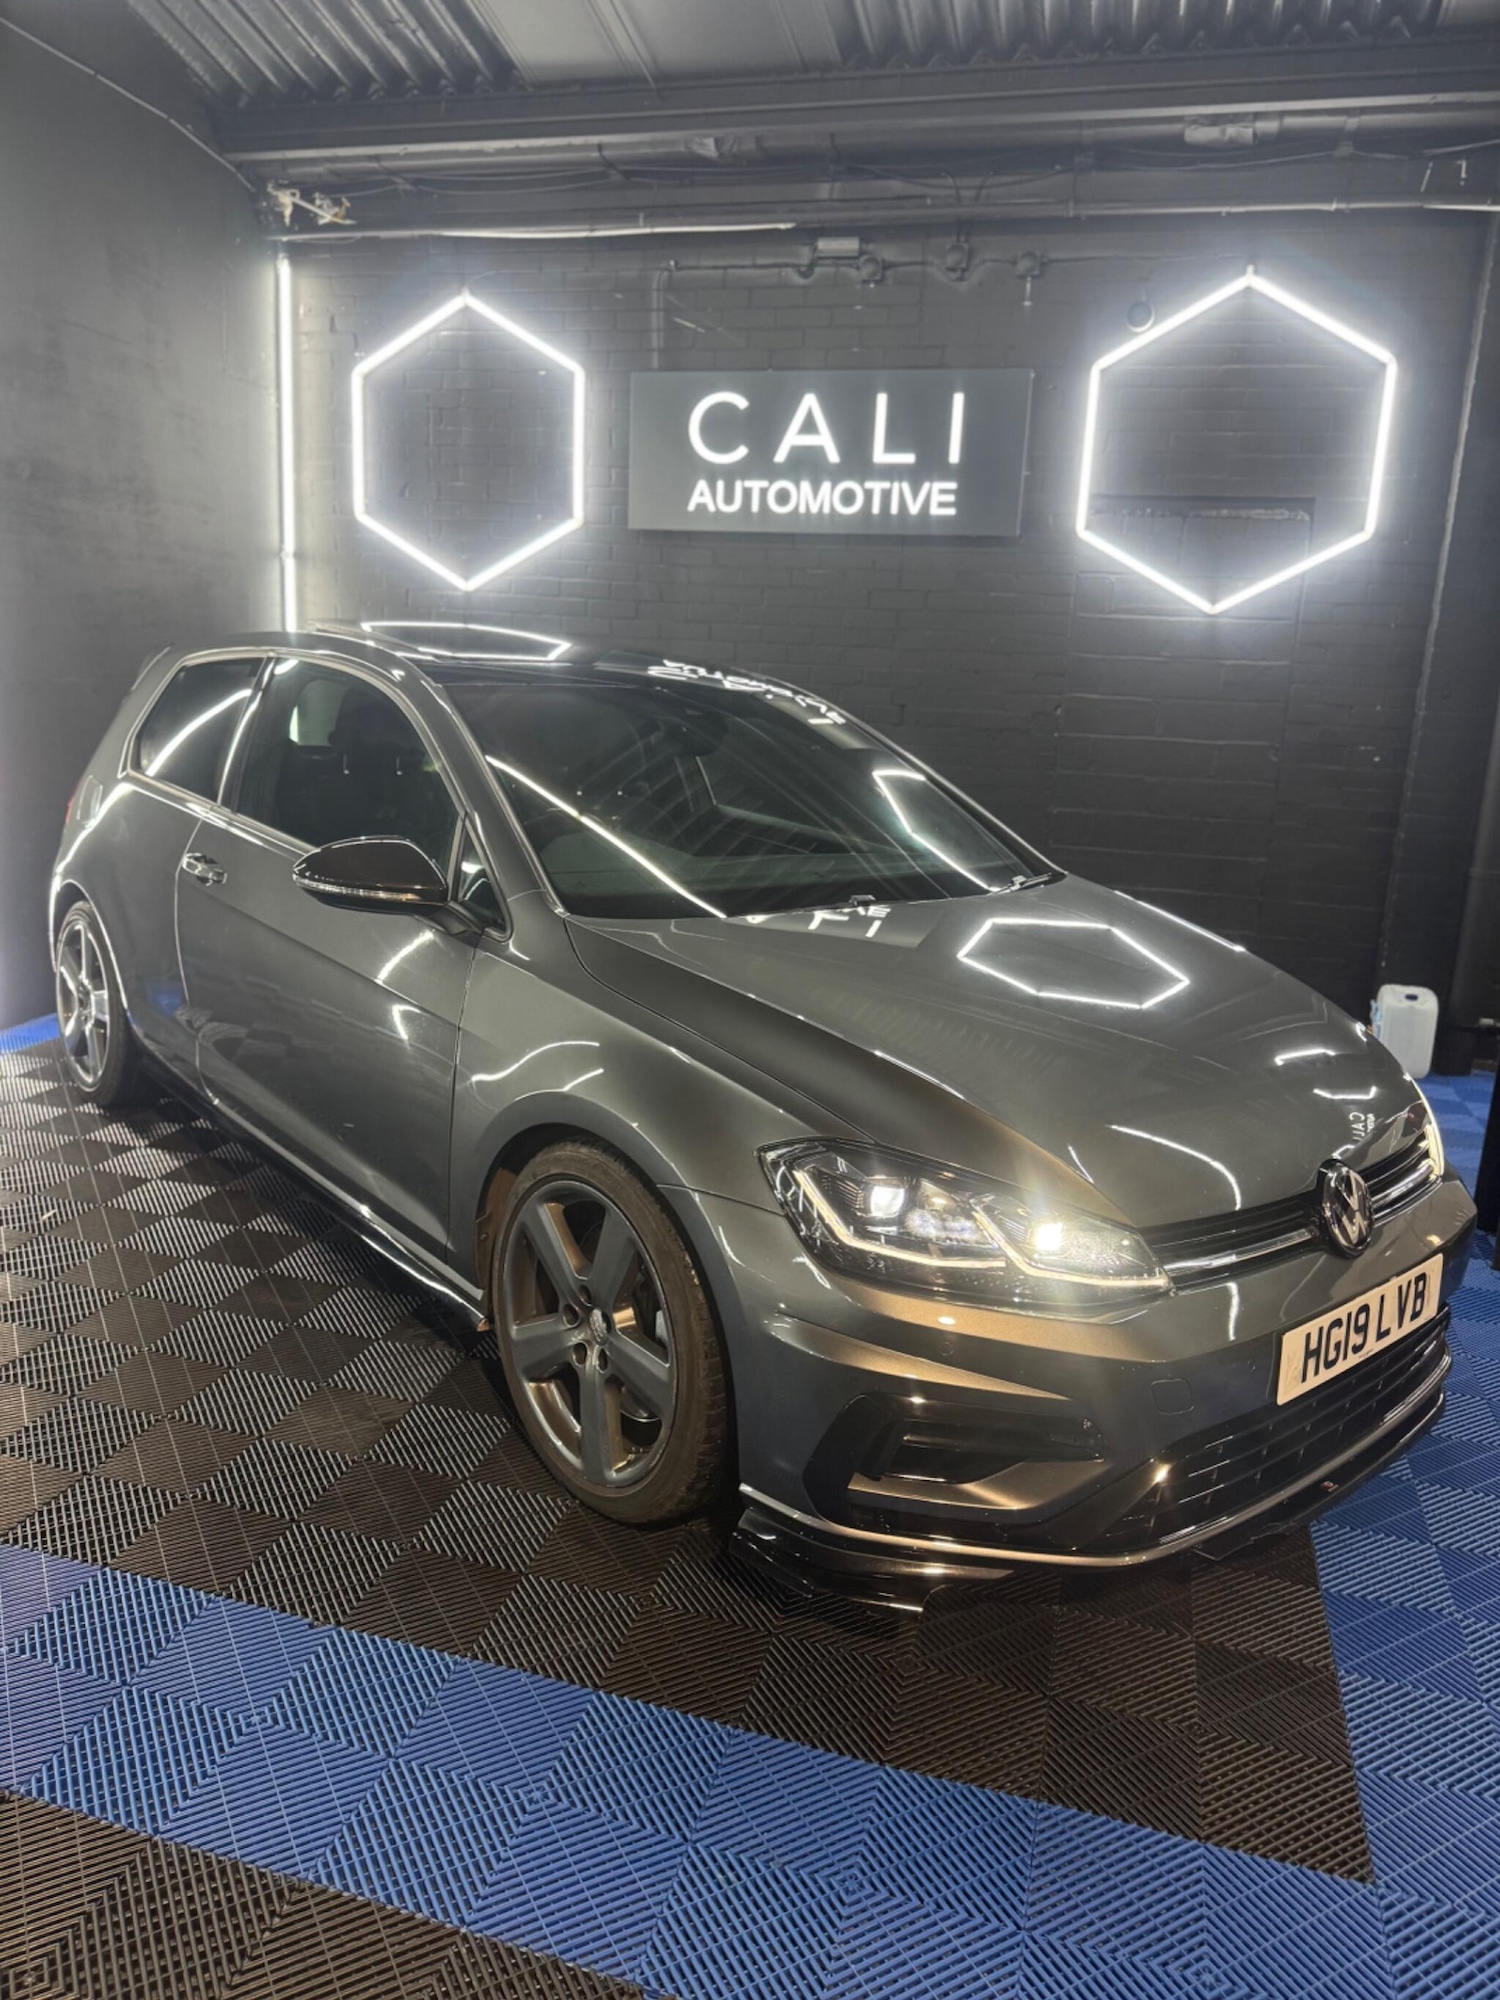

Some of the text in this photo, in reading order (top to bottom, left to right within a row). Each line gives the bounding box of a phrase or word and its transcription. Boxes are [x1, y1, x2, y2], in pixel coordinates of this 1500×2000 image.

[688, 391, 965, 464] CALI
[687, 479, 958, 515] AUTOMOTIVE
[1301, 1272, 1427, 1384] HG19 LVB
